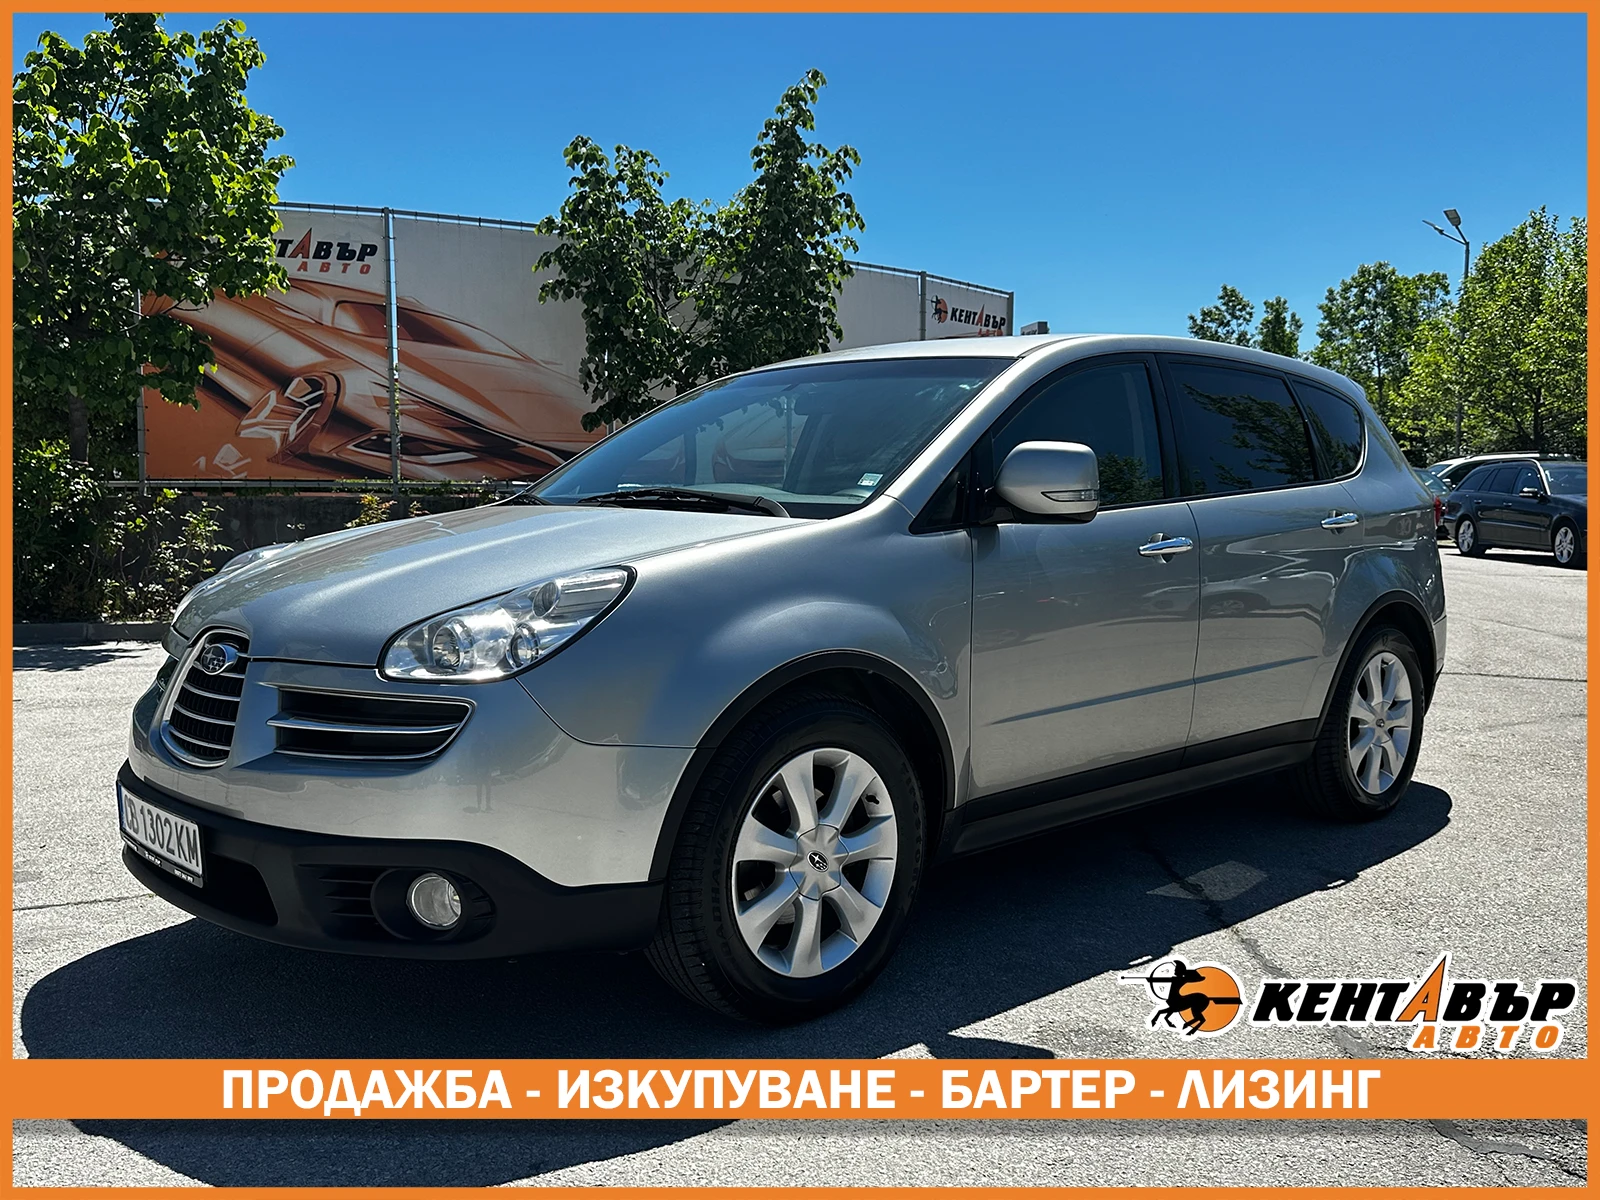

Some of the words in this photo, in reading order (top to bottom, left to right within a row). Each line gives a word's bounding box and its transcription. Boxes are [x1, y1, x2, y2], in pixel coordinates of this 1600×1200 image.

[274, 227, 378, 262] ТАВЪР
[297, 261, 372, 275] АВТО
[950, 304, 1007, 330] КЕНТАВЪР
[140, 805, 175, 856] 1302
[710, 824, 738, 970] OADHAWK
